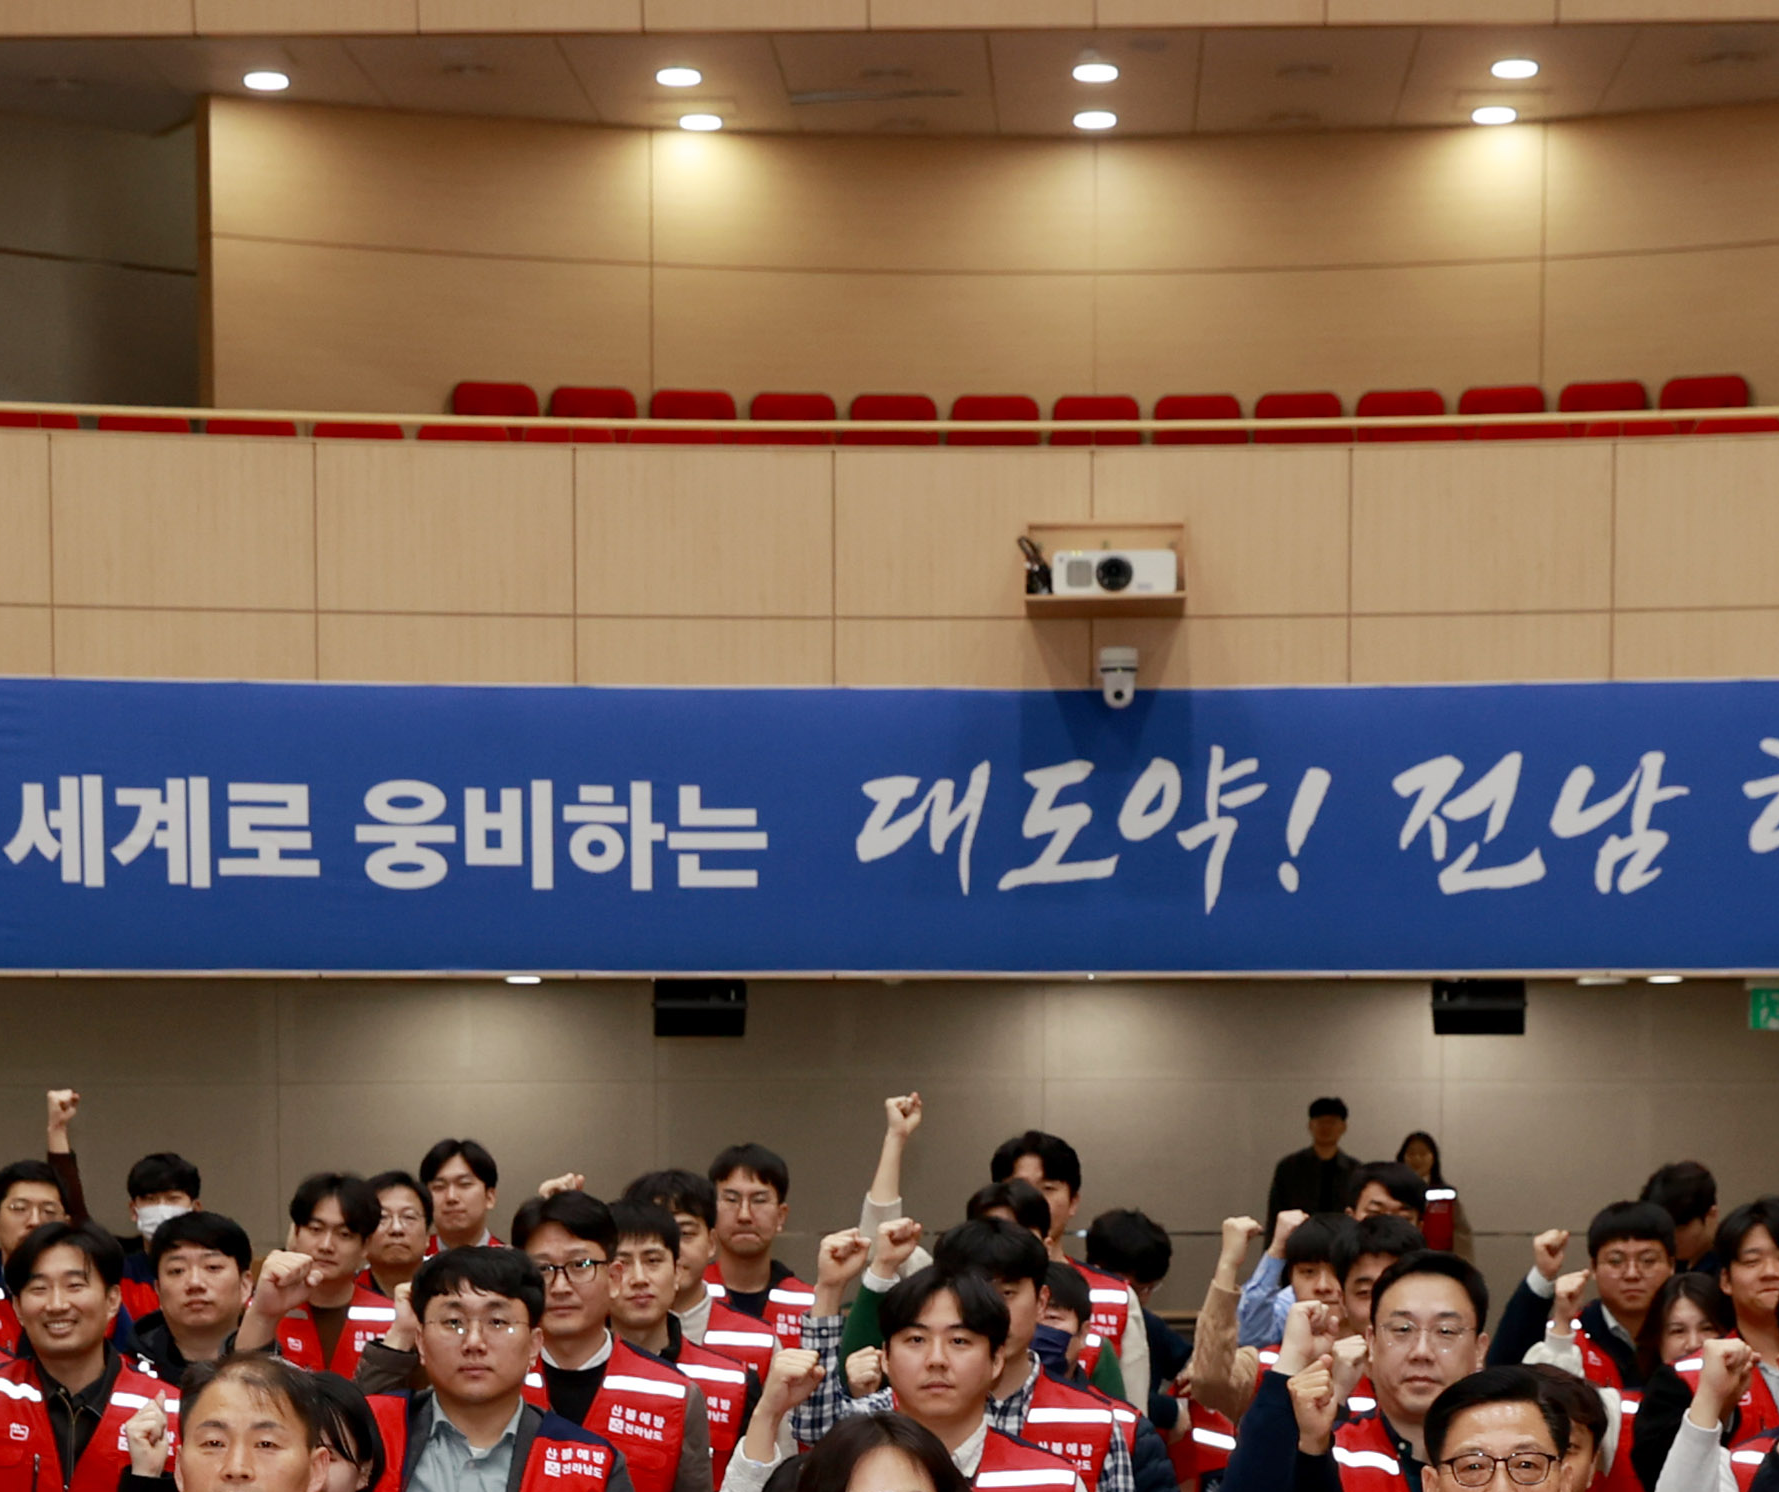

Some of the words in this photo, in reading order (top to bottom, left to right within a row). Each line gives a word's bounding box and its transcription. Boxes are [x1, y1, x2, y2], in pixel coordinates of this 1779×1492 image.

[3, 774, 321, 889] 세계로
[355, 779, 768, 891] 웅비하는
[856, 744, 1332, 914] 대도약!
[1392, 751, 1690, 895] 전남
[610, 1404, 666, 1429] 산불예방
[623, 1423, 664, 1442] 전라남도
[546, 1447, 606, 1465] 산불예방
[561, 1463, 604, 1479] 전라남도
